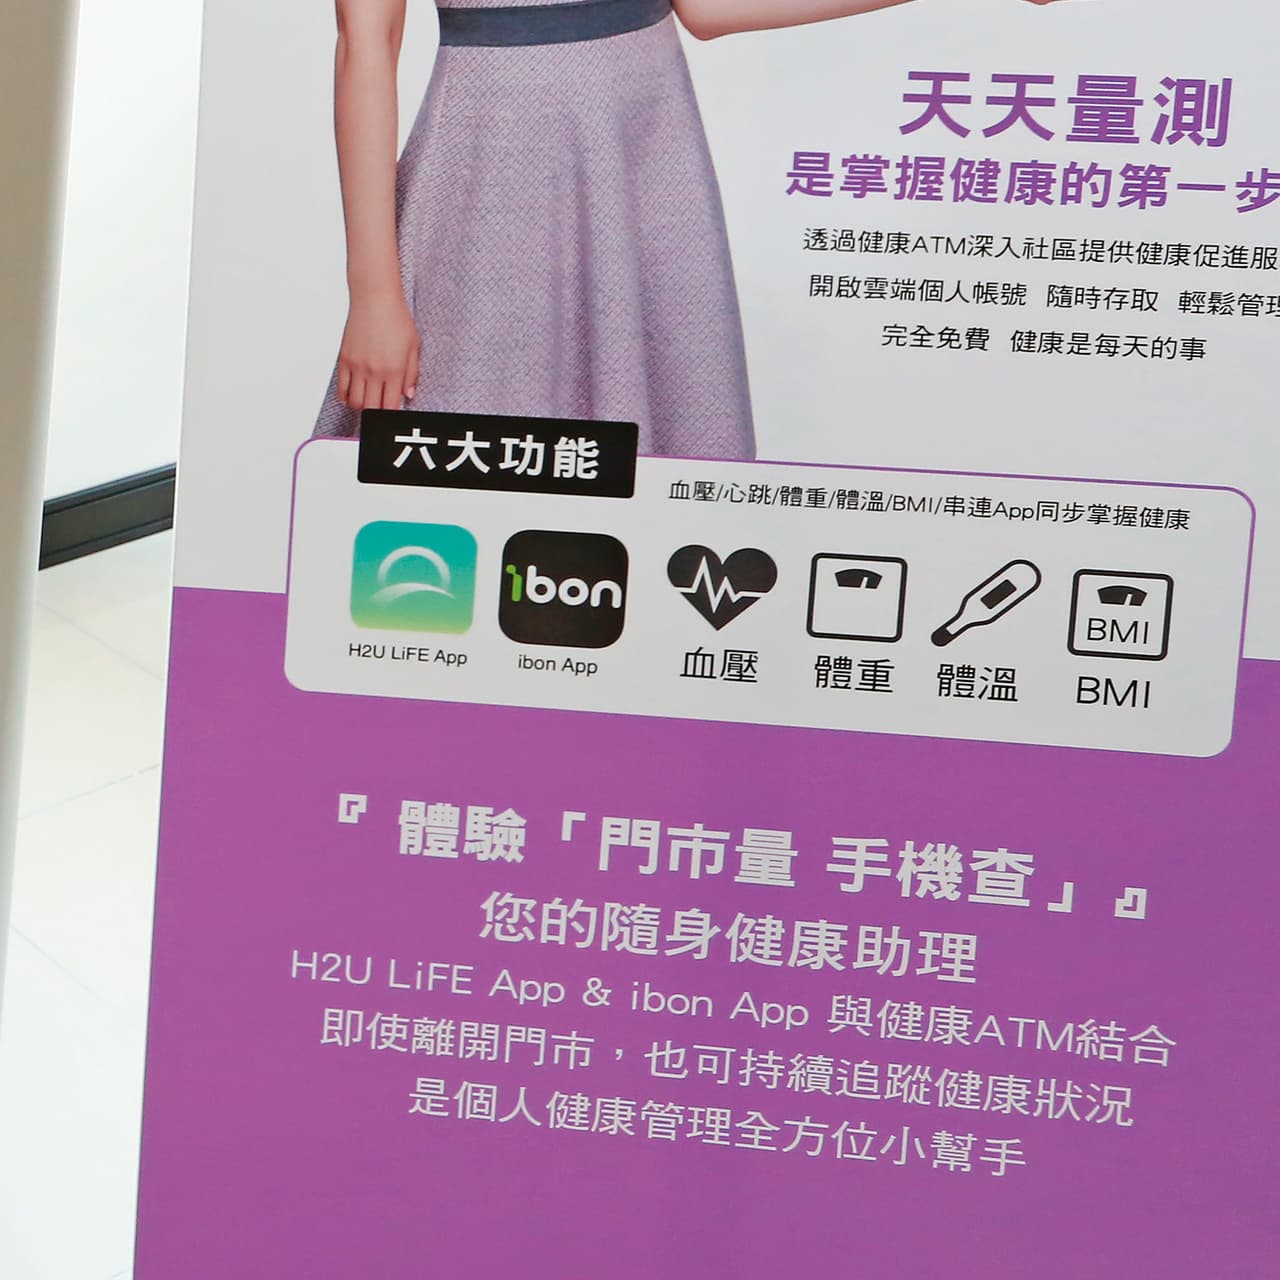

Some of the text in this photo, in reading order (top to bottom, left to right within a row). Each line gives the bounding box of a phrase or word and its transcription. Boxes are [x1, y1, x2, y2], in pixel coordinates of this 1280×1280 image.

[899, 71, 1233, 148] 天天量測
[785, 151, 1280, 213] 是掌握健康的第一步
[809, 274, 1027, 307] 開啟雲端個人帳號
[1046, 283, 1159, 313] 隨時存取
[882, 323, 1208, 361] 完全免費 健康是每天的事
[393, 428, 600, 480] 六大功能
[506, 564, 622, 609] ibon
[1086, 617, 1149, 645] BMI
[348, 643, 468, 667] H2U LiFE App
[518, 654, 599, 677] ibon App
[679, 646, 759, 684] 血壓
[814, 655, 895, 693] 體重
[936, 663, 1019, 702] 體溫
[1076, 676, 1150, 709] BMI
[479, 891, 977, 984] 您的隨身健康助理
[291, 950, 1177, 1067] H2U LiFE App & ibon App 與健康ATM結合
[408, 1077, 1027, 1176] 是個人健康管理全方位小幫手
